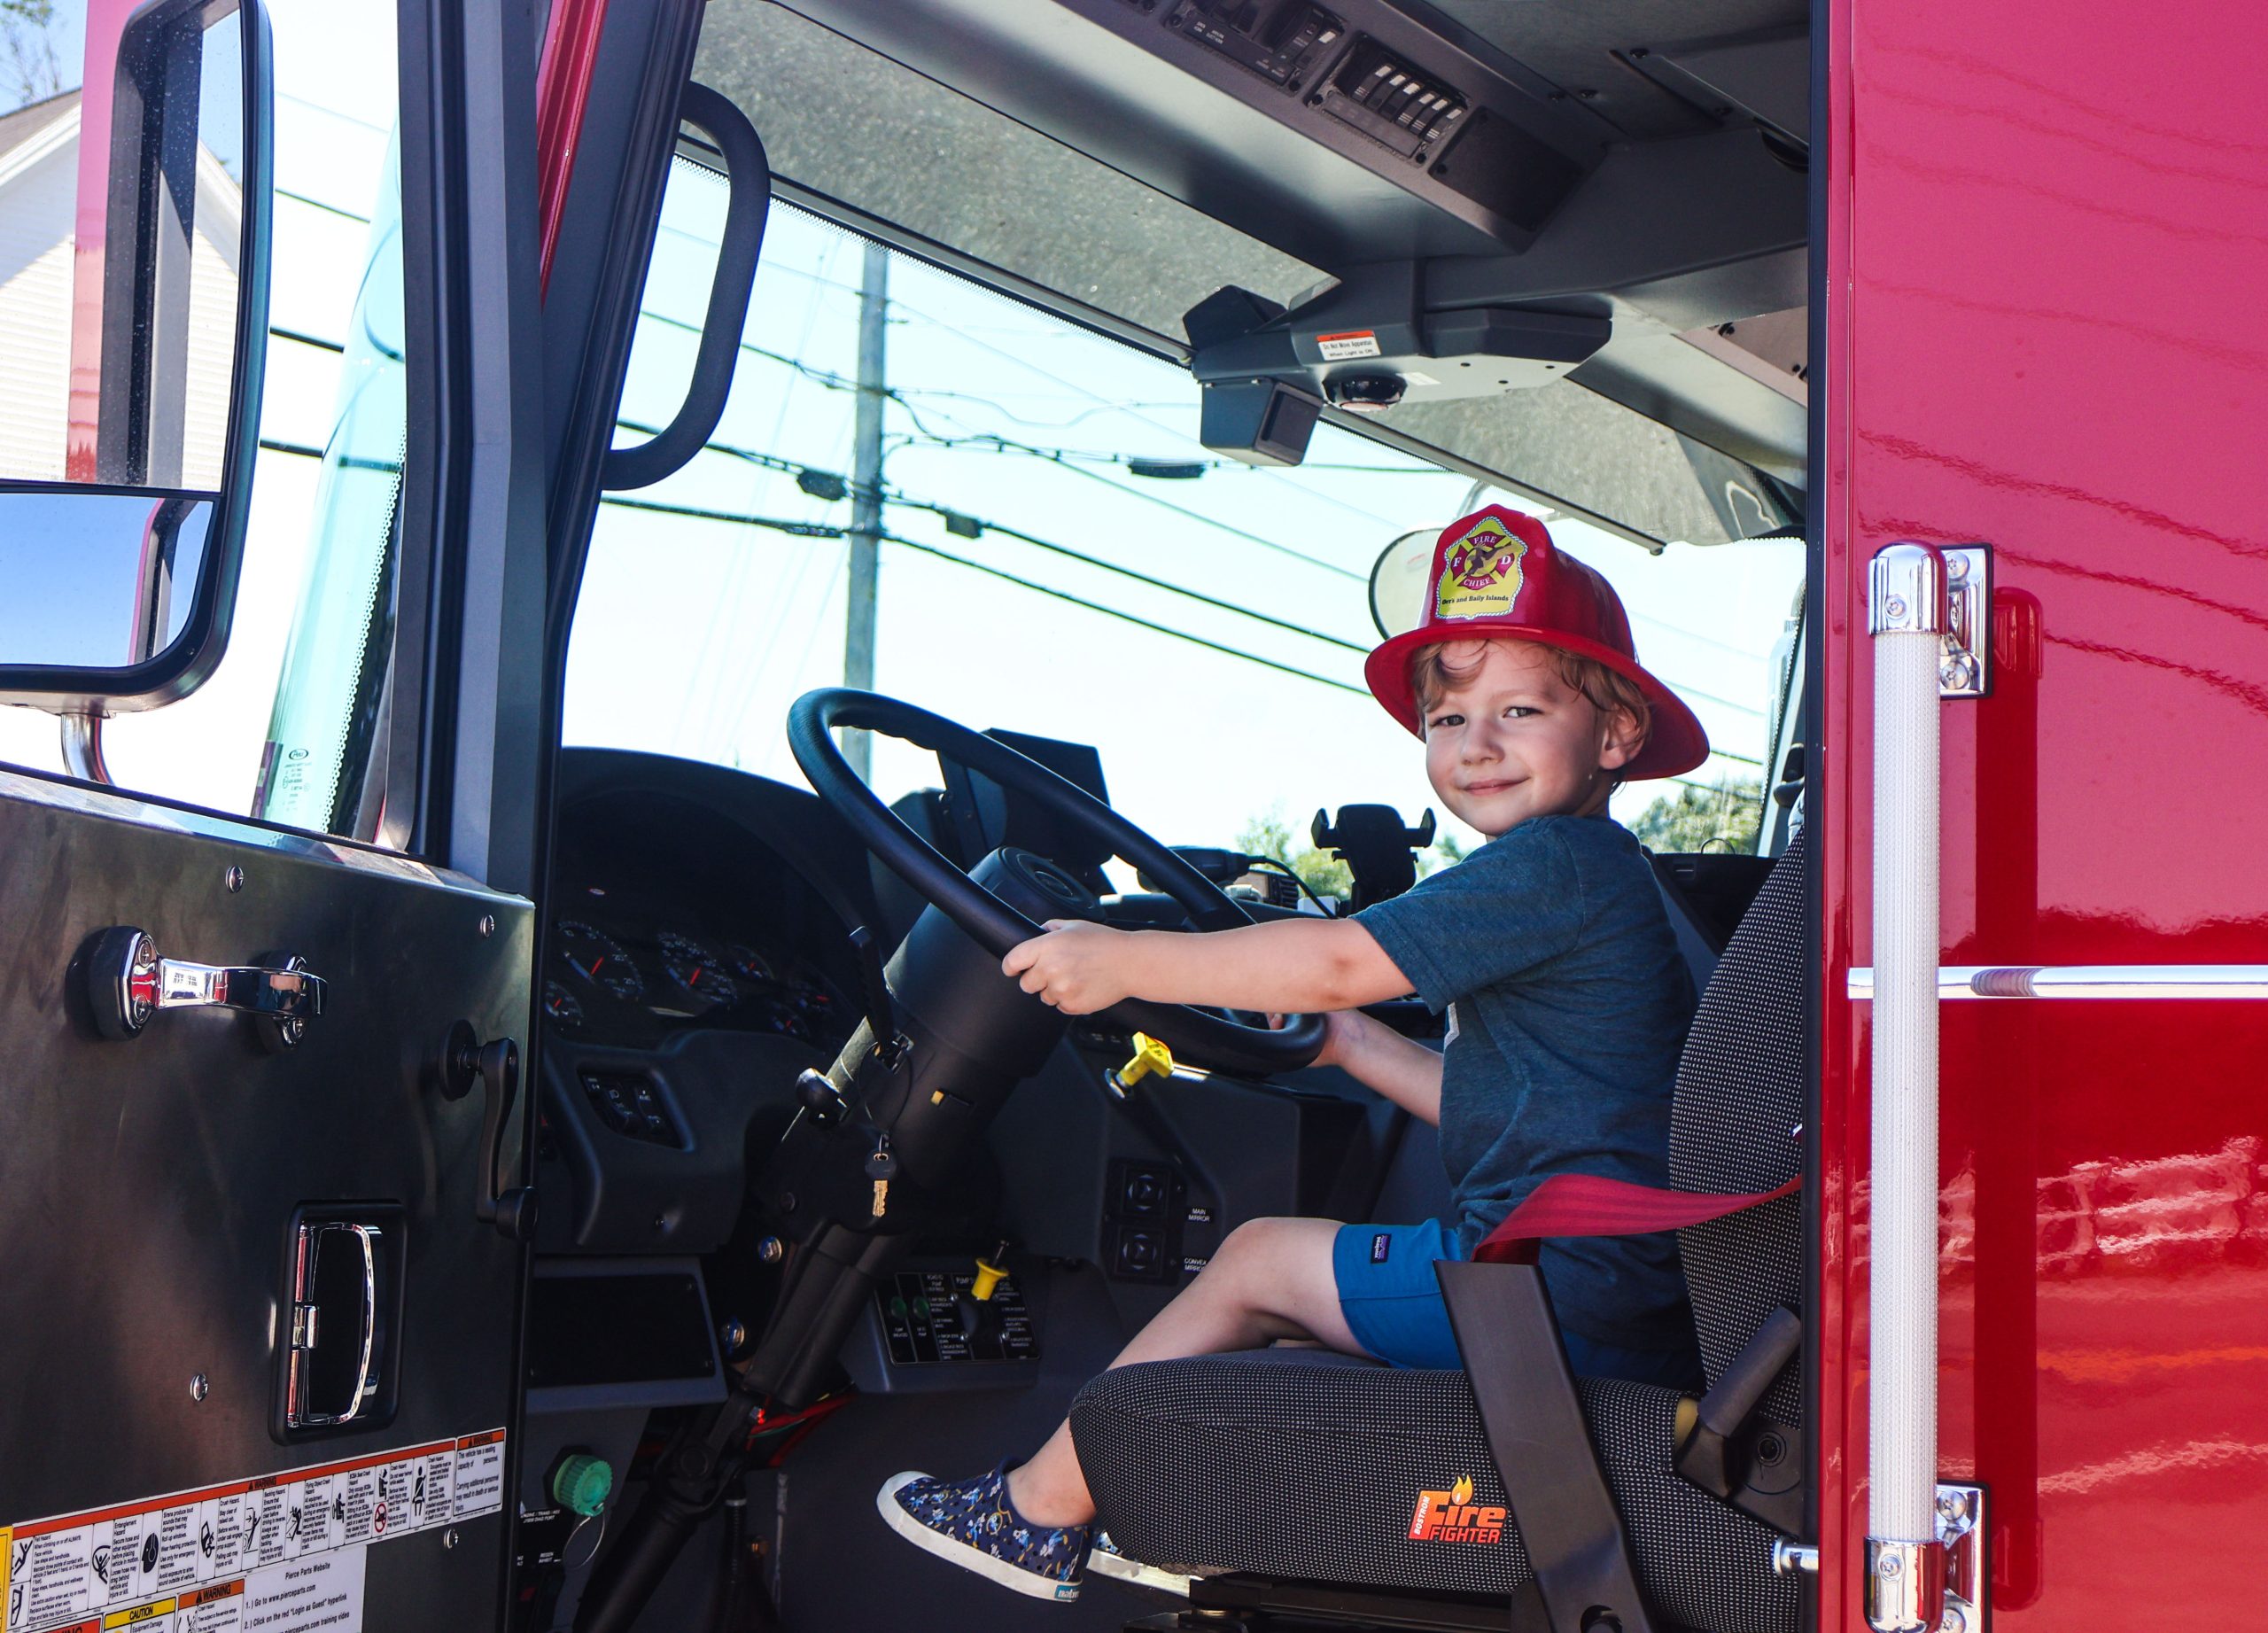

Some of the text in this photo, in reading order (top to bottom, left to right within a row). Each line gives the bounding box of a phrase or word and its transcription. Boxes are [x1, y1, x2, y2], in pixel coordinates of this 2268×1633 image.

[1474, 536, 1497, 544] FIRE
[1453, 555, 1511, 567] F D
[1464, 578, 1490, 587] CHIEF
[1409, 1490, 1506, 1540] Fire
[1414, 1495, 1430, 1535] BOSTROM
[1429, 1526, 1501, 1544] FIGHTER
[285, 1561, 330, 1580] Pierce Parts Website
[203, 1583, 231, 1600] WARNING
[254, 1597, 261, 1607] Go
[262, 1596, 267, 1605] to
[268, 1583, 316, 1604] www.pierceparts.com
[129, 1605, 154, 1620] CAUTION
[253, 1615, 264, 1626] Click
[327, 1592, 347, 1607] hyperlink
[320, 1614, 337, 1627] training
[338, 1609, 349, 1620] video
[132, 1618, 163, 1633] Equipment Damage
